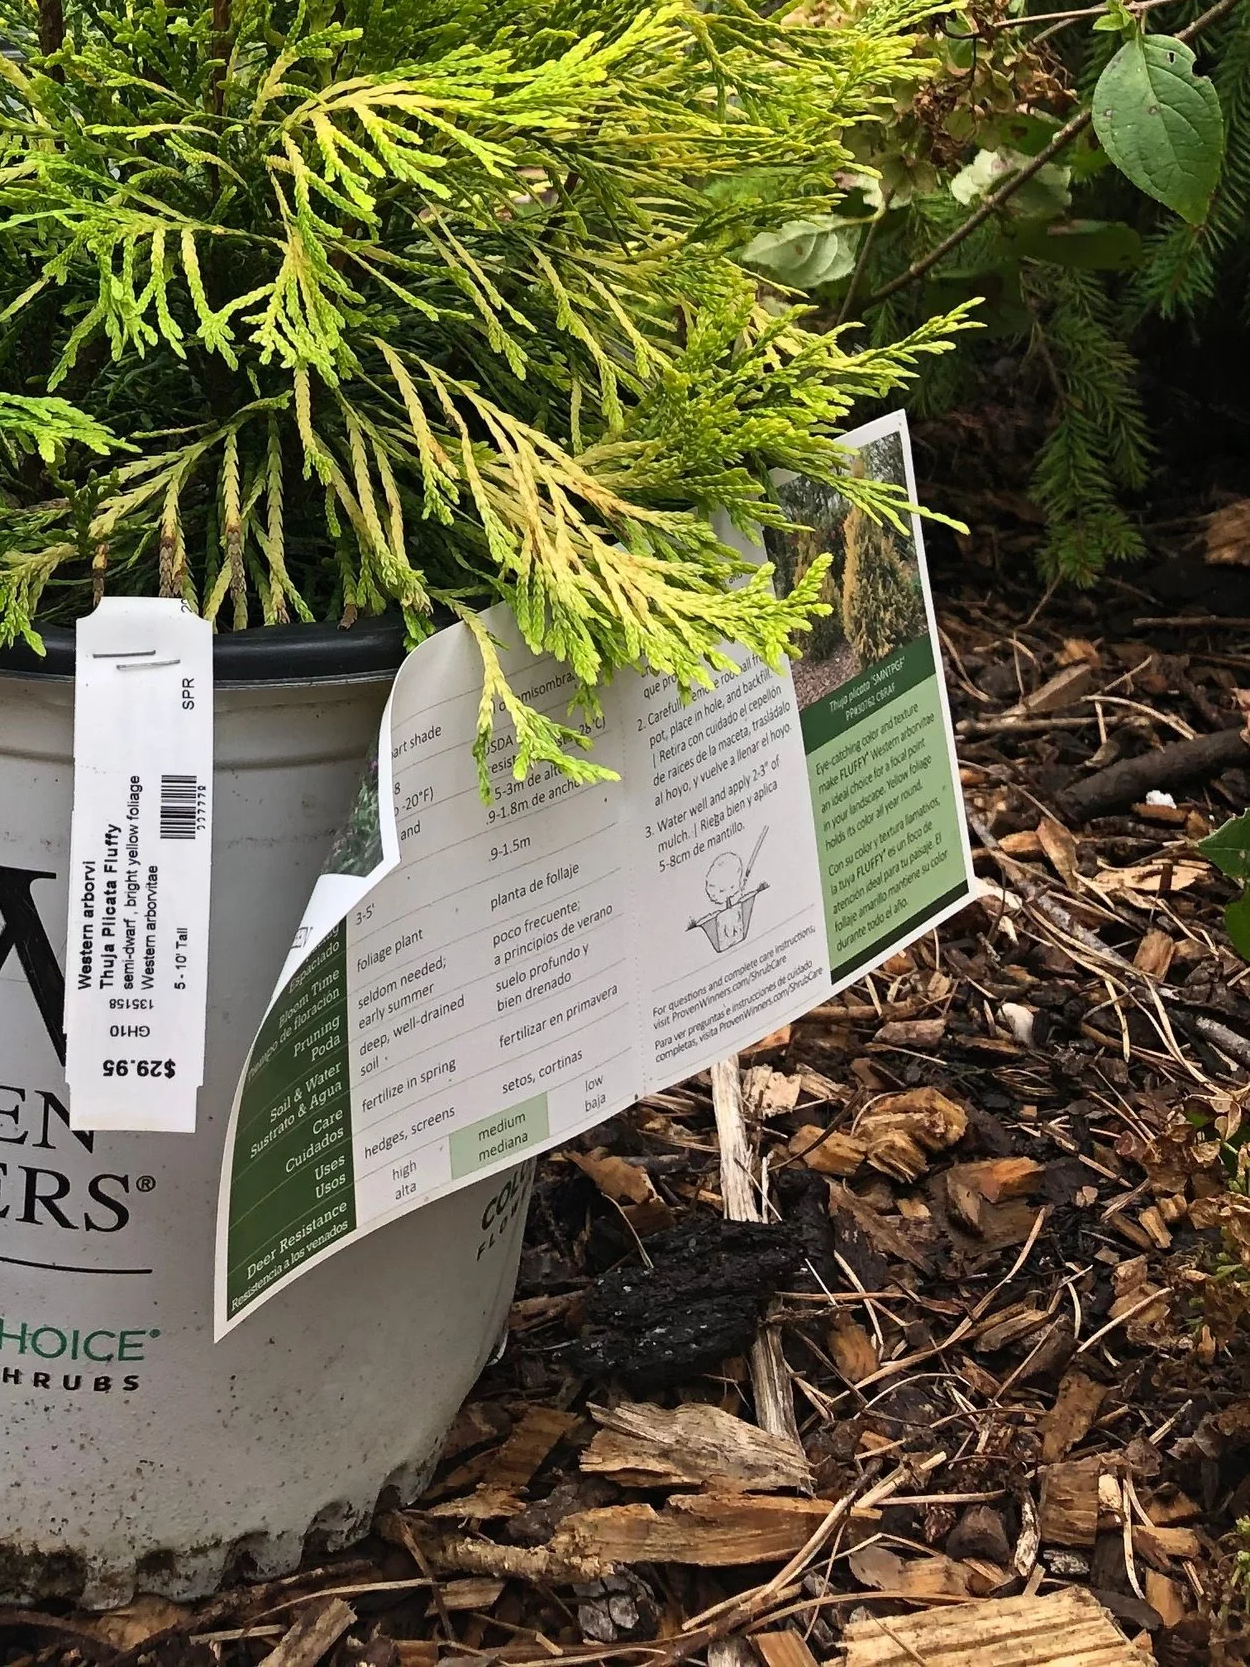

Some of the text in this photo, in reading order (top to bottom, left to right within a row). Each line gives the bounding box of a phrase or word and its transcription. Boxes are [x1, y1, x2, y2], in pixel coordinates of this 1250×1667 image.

[182, 677, 195, 710] SPR
[670, 716, 692, 735] place
[695, 711, 702, 722] in
[704, 699, 724, 715] hole,
[727, 690, 741, 704] and
[410, 725, 441, 748] shade
[660, 741, 687, 763] Retira
[688, 732, 704, 751] con
[706, 713, 738, 737] cuidado
[740, 705, 747, 718] el
[127, 775, 143, 821] foliage
[532, 789, 546, 807] de
[657, 809, 687, 832] Water
[689, 799, 707, 816] well
[710, 787, 726, 807] and
[728, 776, 750, 800] apply
[771, 754, 780, 771] of
[400, 820, 421, 841] and
[658, 833, 690, 853] mulch.
[727, 800, 745, 817] bien
[753, 780, 778, 802] aplica
[126, 824, 141, 866] yellow
[659, 822, 745, 872] 5-8cm de mantillo.
[100, 824, 122, 989] Thuja Plicata Fluffy
[124, 870, 140, 907] bright
[490, 864, 579, 911] planta de follaje
[78, 861, 96, 990] Western arborvi
[141, 865, 158, 990] Western arborvitae
[176, 927, 188, 949] Tall
[493, 901, 580, 948] poco frecuente;
[494, 904, 613, 965] a principios de verano
[175, 953, 187, 970] 10'
[357, 929, 423, 972] foliage plant
[496, 943, 589, 992] suelo profundo y
[109, 998, 154, 1010] 135158
[279, 969, 340, 1029] Bloom Time
[358, 957, 446, 1009] seldom needed;
[497, 971, 571, 1012] bien drenado
[653, 1004, 667, 1017] For
[669, 984, 707, 1011] questions
[709, 976, 723, 991] and
[724, 959, 758, 983] complete
[759, 950, 774, 962] care
[359, 983, 434, 1029] early summer
[359, 994, 465, 1056] deep, well-drained
[499, 984, 618, 1048] fertilizar en primavera
[654, 1017, 670, 1029] visit
[109, 1025, 151, 1037] GH10
[280, 1027, 292, 1043] de
[294, 1015, 340, 1057] Pruning
[311, 1034, 340, 1061] Poda
[102, 1058, 176, 1079] $29.95
[360, 1056, 379, 1076] soil
[362, 1058, 456, 1112] fertilize in spring
[502, 1049, 583, 1094] setos, cortinas
[585, 1075, 603, 1092] low
[270, 1062, 341, 1123] Soil & Water
[584, 1093, 606, 1112] baja
[251, 1116, 294, 1158] Sustrato
[310, 1081, 342, 1112] Agua
[313, 1109, 343, 1135] Care
[364, 1105, 455, 1159] hedges, screens
[478, 1111, 526, 1141] medium
[286, 1127, 344, 1173] Cuidados
[315, 1155, 345, 1180] Uses
[479, 1131, 528, 1162] mediana
[316, 1174, 346, 1198] Usos
[392, 1160, 417, 1181] high
[395, 1182, 417, 1200] alta
[247, 1202, 347, 1279] Deer Resistance
[231, 1222, 348, 1311] Resistencia a los venados
